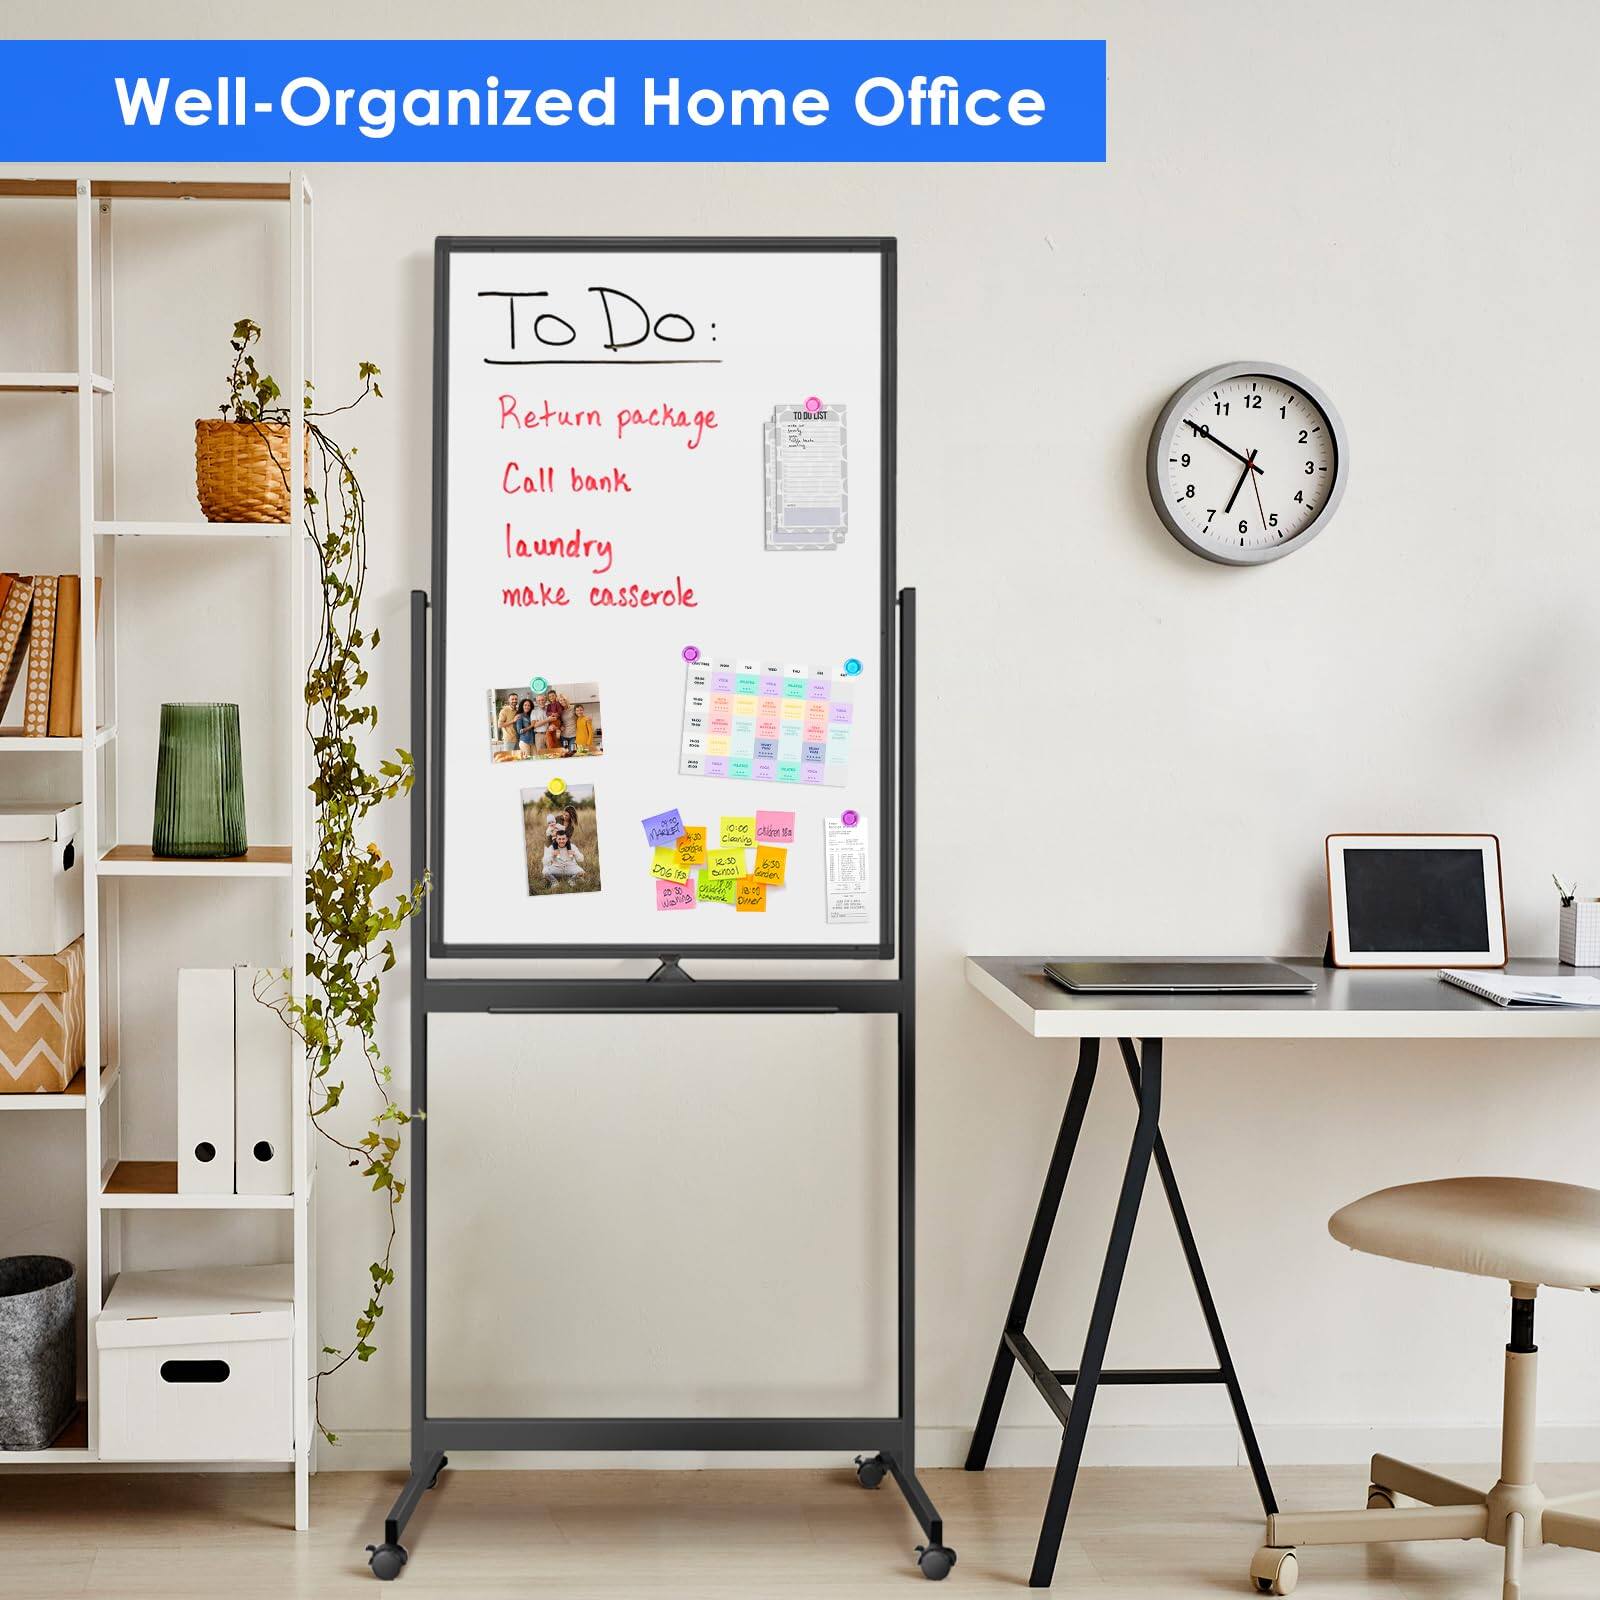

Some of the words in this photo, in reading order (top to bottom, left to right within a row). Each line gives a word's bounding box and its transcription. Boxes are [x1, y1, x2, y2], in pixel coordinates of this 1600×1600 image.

[478, 291, 577, 350] To
[1214, 402, 1230, 416] 11
[1244, 395, 1262, 409] 12
[793, 411, 802, 420] TO
[813, 411, 828, 420] LIST
[1279, 406, 1287, 420] 1
[498, 394, 601, 429] Return
[617, 403, 718, 450] package
[1298, 430, 1308, 444] 2
[1181, 454, 1191, 468] 9
[1304, 461, 1315, 475] 3
[503, 461, 555, 495] Call
[570, 465, 632, 493] bank
[1185, 485, 1195, 498] 8
[1294, 490, 1303, 504] 4
[1207, 509, 1216, 523] 7
[1269, 513, 1279, 527] 5
[1238, 520, 1248, 534] 6
[506, 523, 613, 574] laundry
[502, 581, 570, 608] make
[589, 575, 698, 609] casserole
